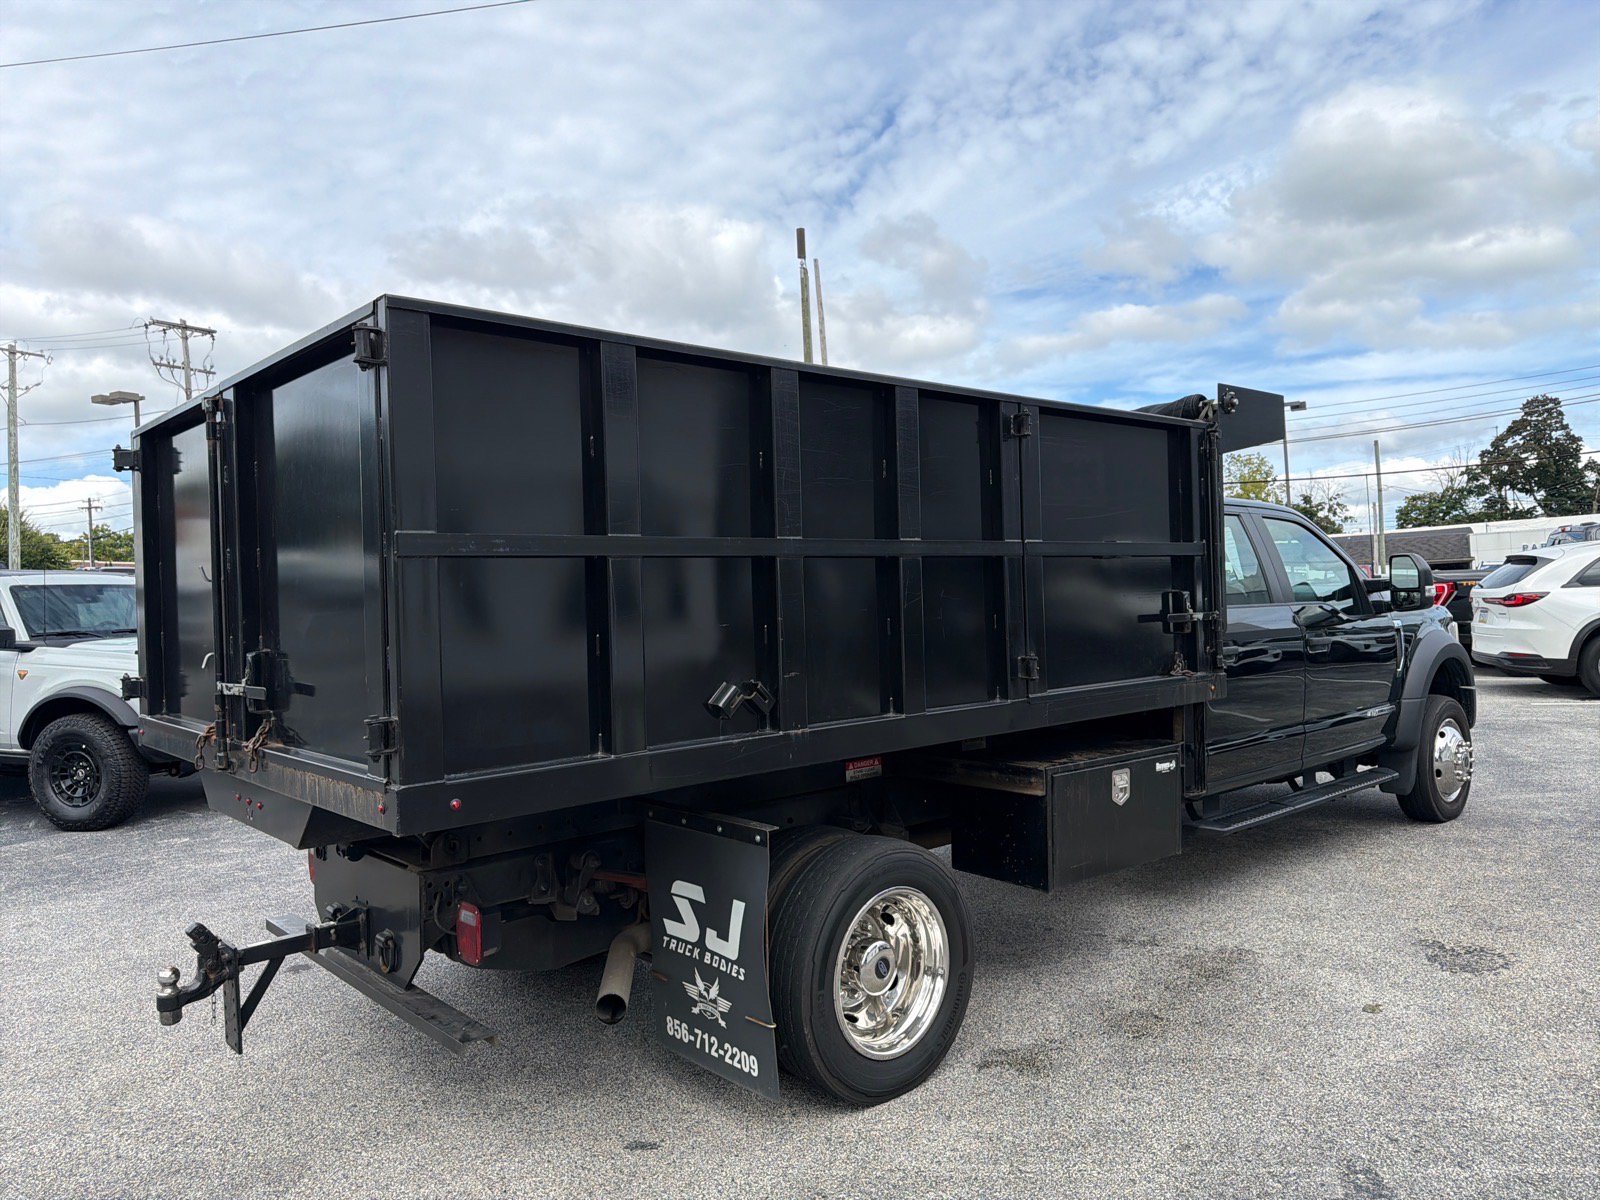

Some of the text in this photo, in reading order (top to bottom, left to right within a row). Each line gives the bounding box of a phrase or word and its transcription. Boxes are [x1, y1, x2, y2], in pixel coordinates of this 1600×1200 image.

[853, 759, 873, 769] DANGER
[662, 880, 746, 961] SJ
[662, 935, 746, 982] TRUCK BODIES
[666, 1015, 759, 1078] 856-712-2209
